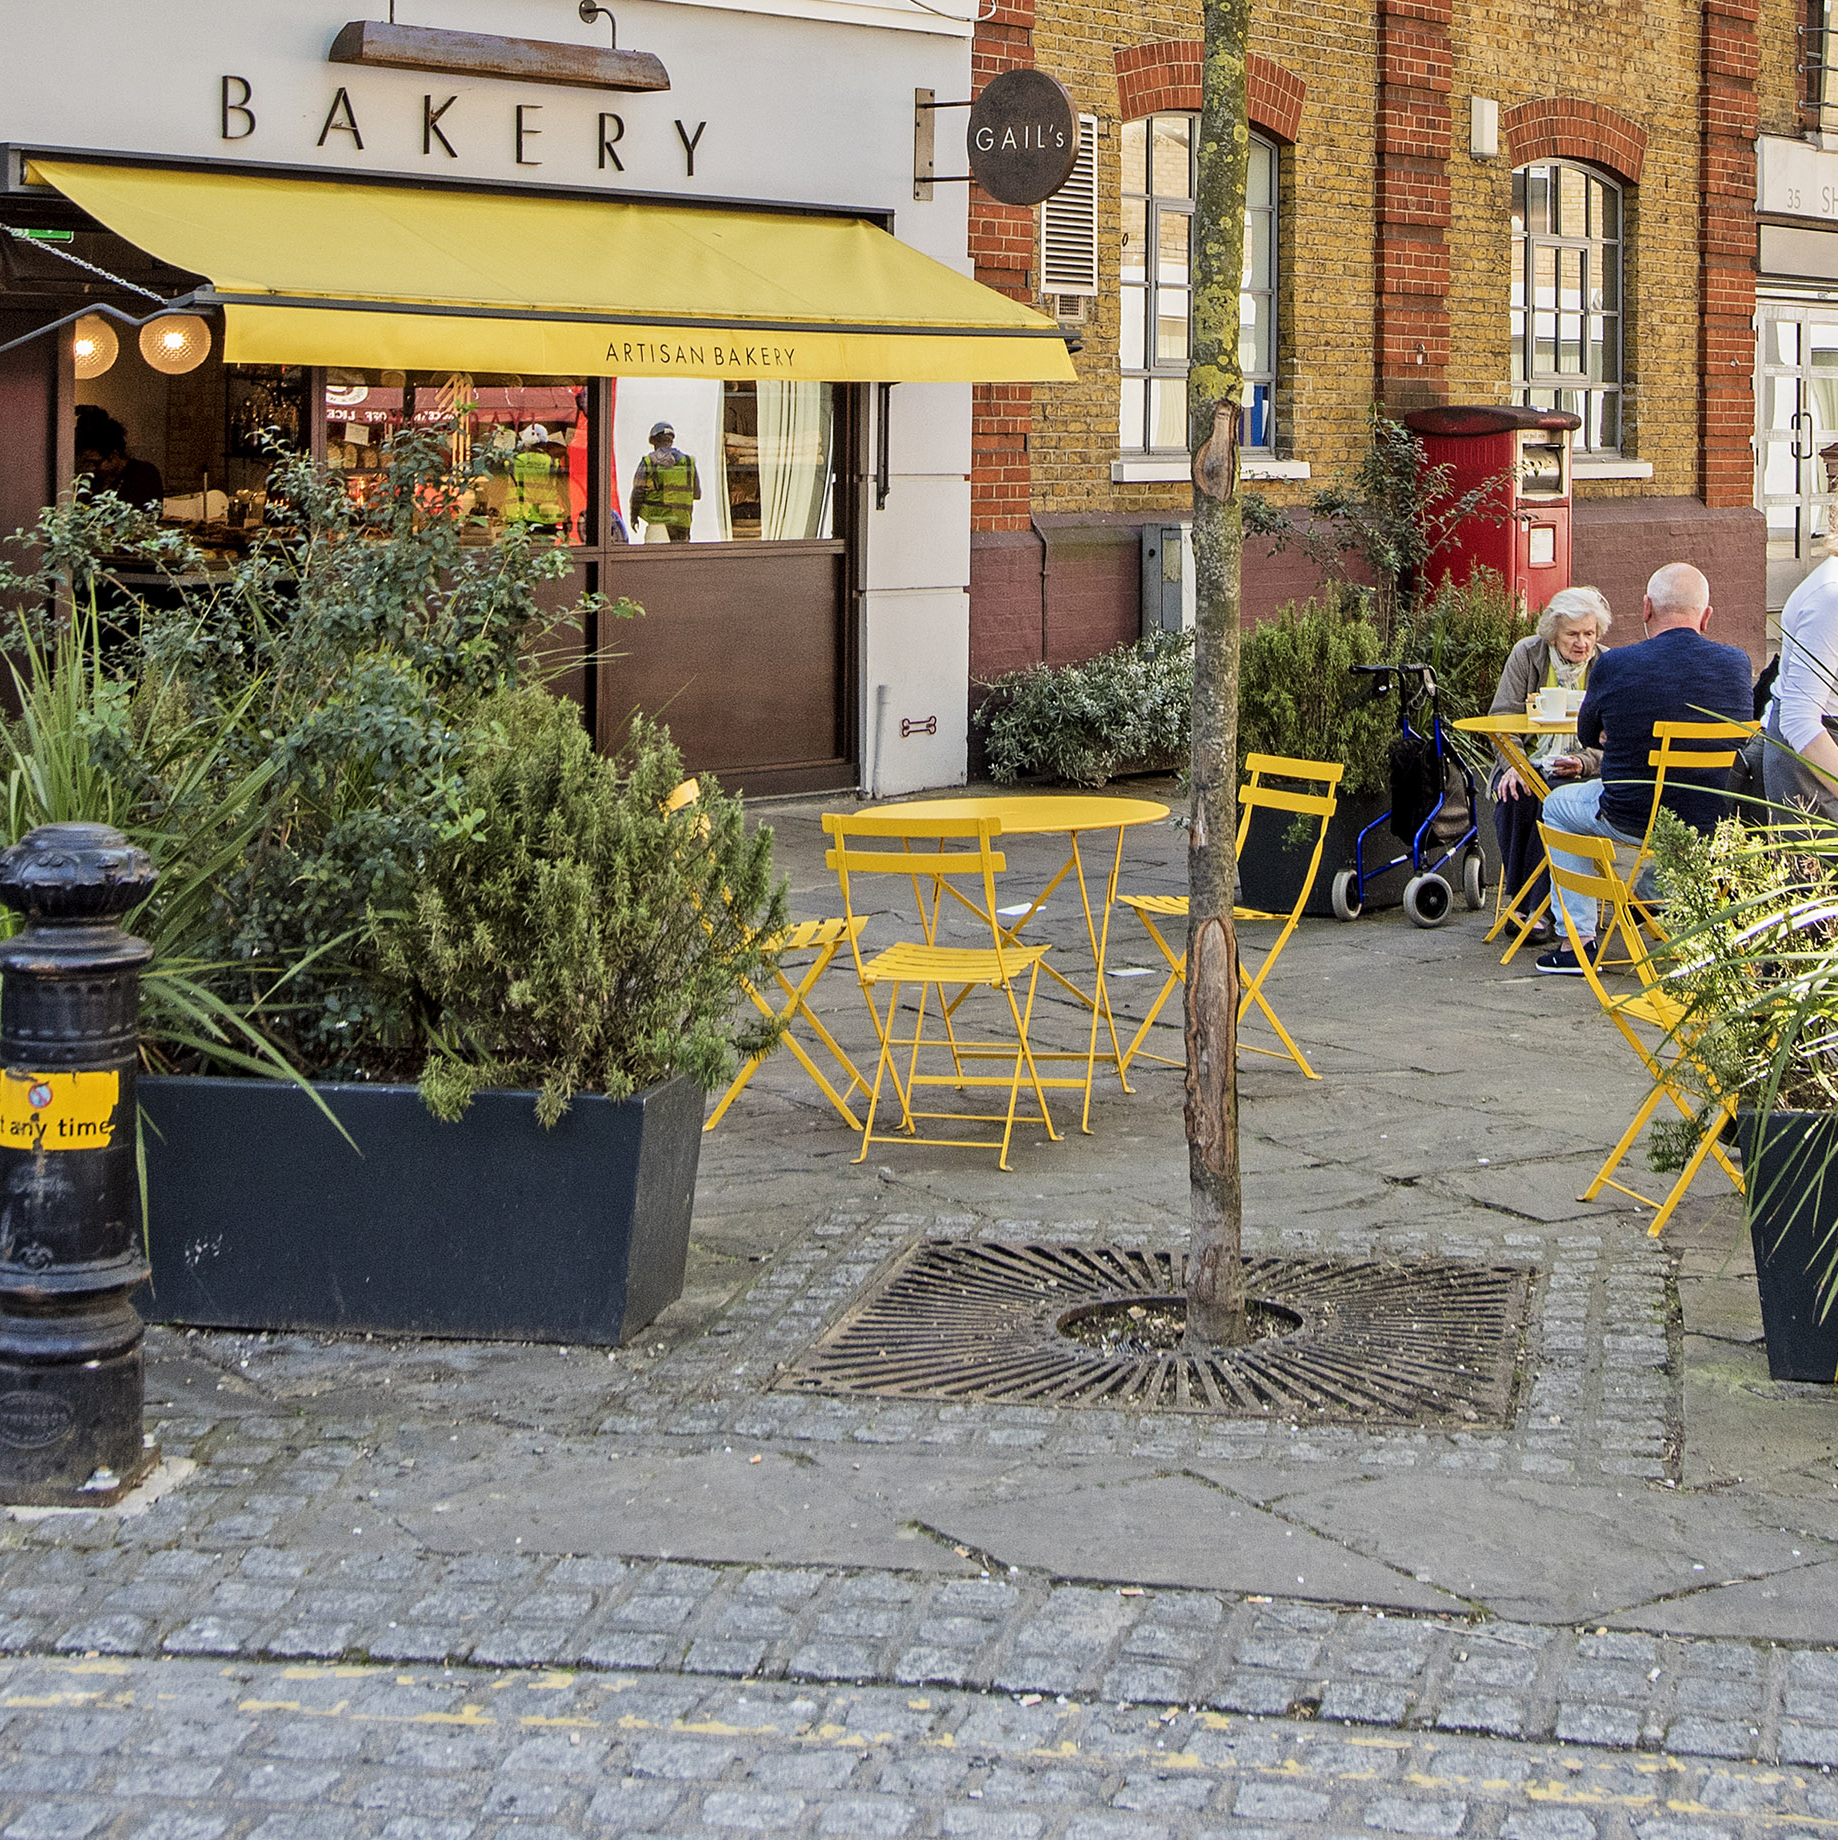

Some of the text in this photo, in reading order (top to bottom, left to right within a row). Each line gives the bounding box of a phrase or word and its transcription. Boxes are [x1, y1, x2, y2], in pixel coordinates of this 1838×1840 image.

[221, 74, 708, 177] BAKERY
[975, 123, 1065, 152] GAIL's
[1786, 188, 1802, 209] 35
[606, 342, 796, 367] ARTISAN BAKERY
[10, 1121, 48, 1140] any
[57, 1117, 110, 1137] time
